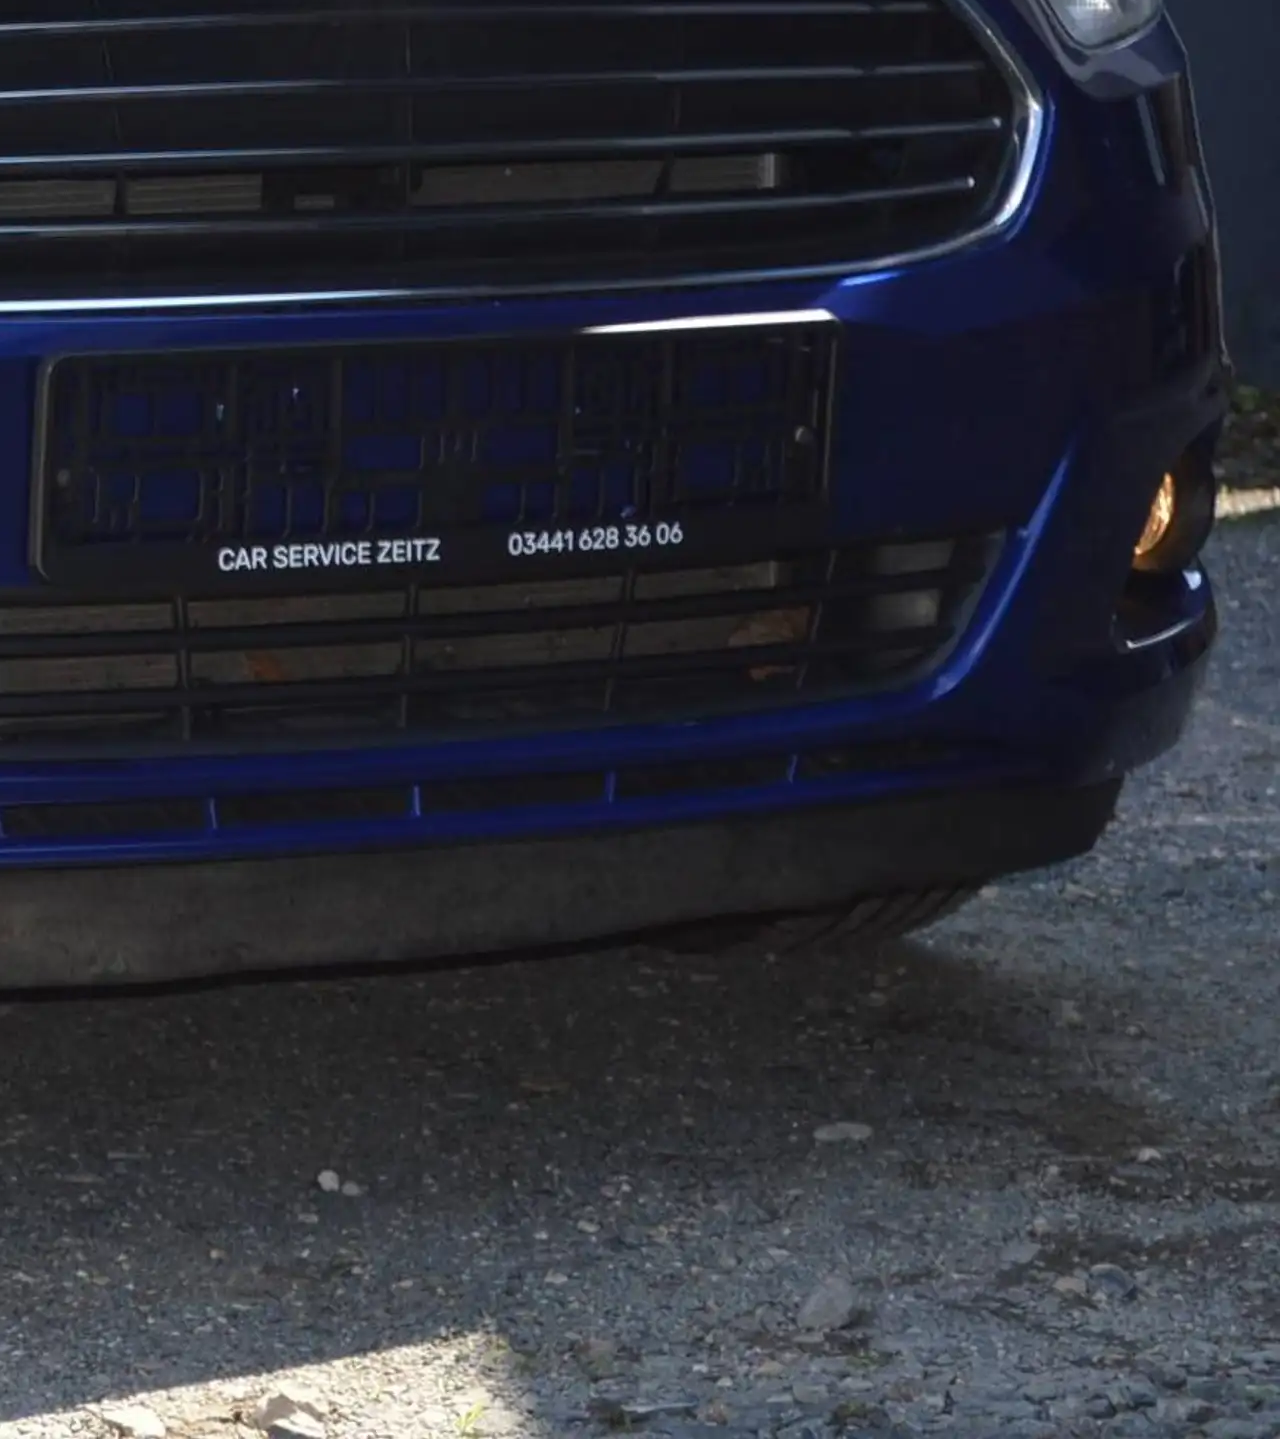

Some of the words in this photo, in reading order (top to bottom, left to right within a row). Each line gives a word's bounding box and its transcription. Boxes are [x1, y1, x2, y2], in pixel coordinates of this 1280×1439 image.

[218, 547, 268, 571] CAR
[273, 541, 372, 569] SERVICE
[377, 537, 441, 563] ZEITZ
[508, 529, 575, 556] 03441
[578, 526, 620, 551] 628
[624, 524, 652, 548] 36
[655, 521, 684, 545] 06
